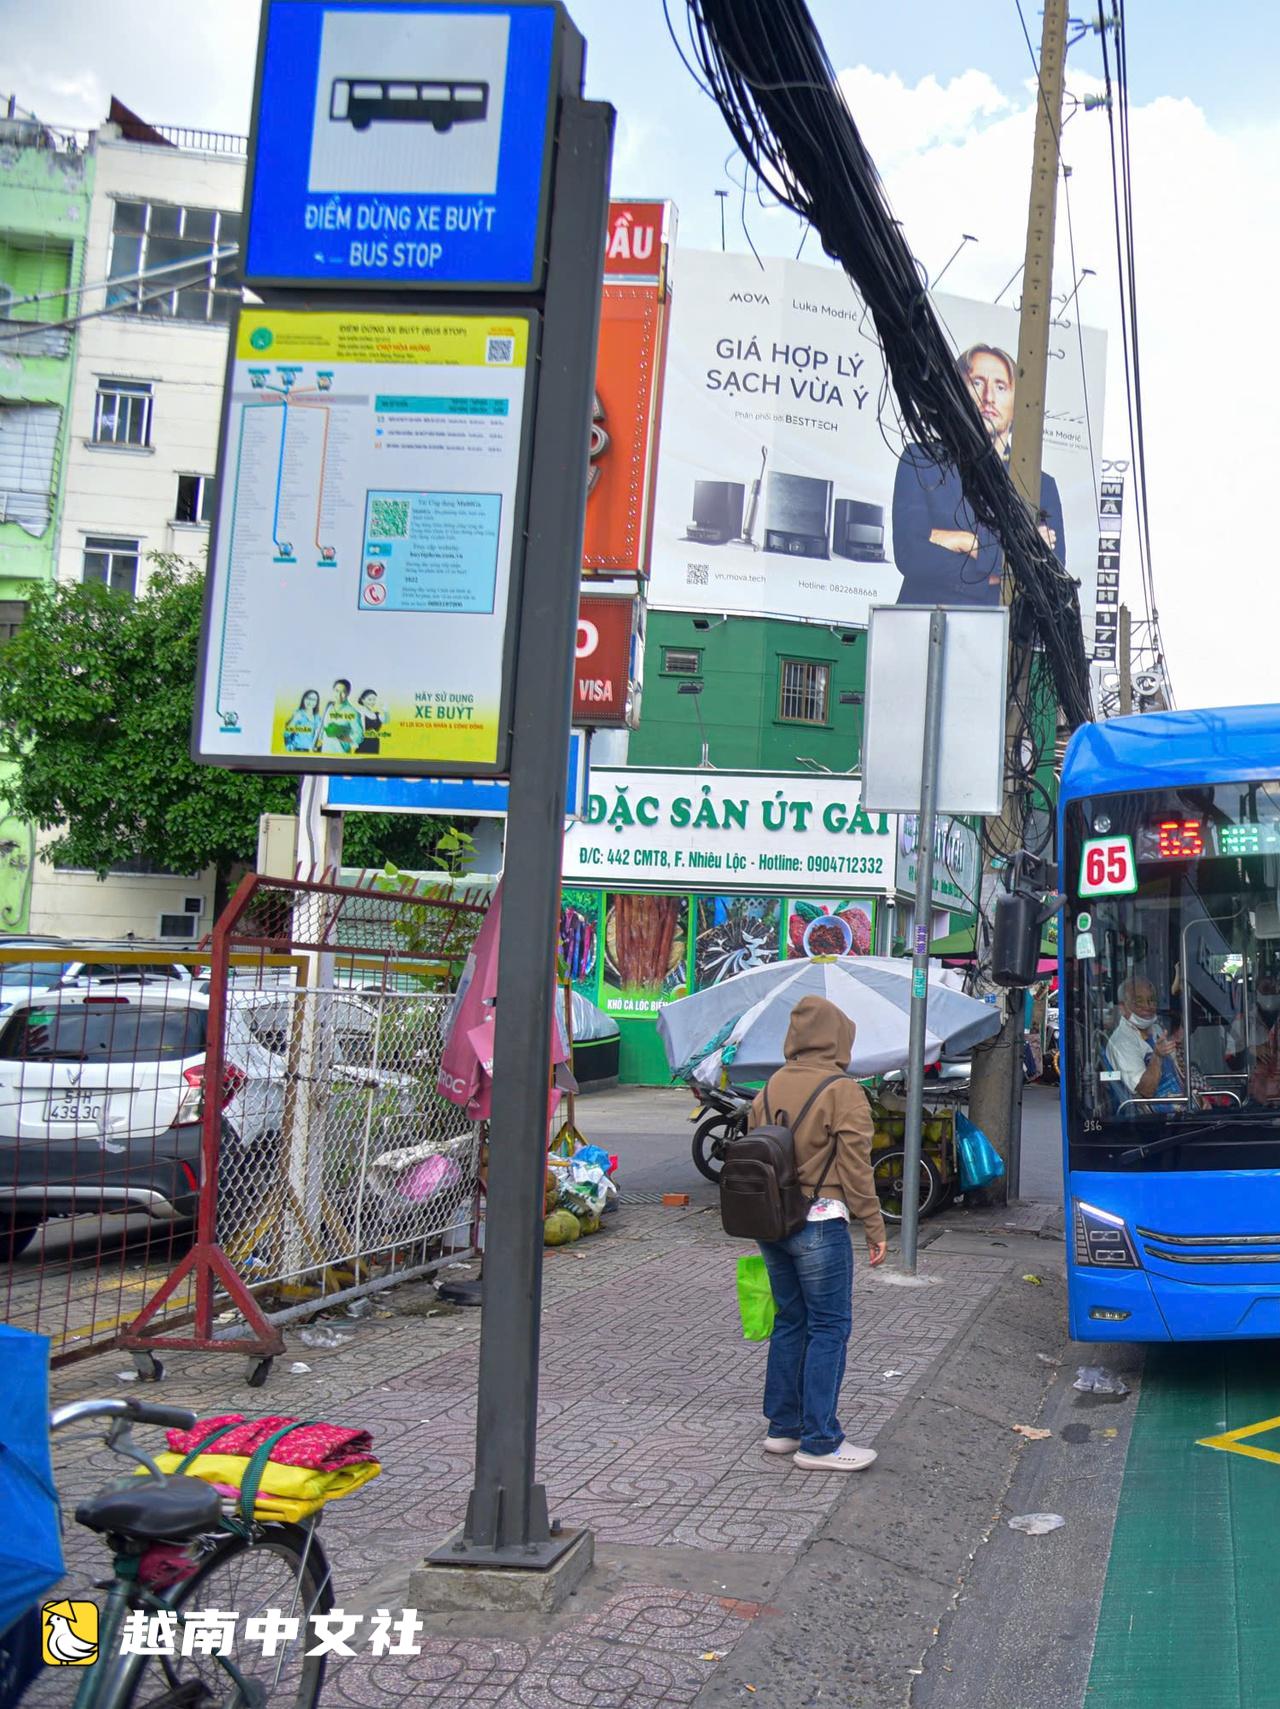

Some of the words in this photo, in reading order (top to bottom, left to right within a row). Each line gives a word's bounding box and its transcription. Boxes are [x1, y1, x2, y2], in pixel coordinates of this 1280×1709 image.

[304, 196, 351, 230] ĐIỂM
[358, 199, 411, 231] DỪNG
[416, 208, 441, 231] XE
[445, 200, 496, 232] BUÝT
[606, 211, 655, 260] ẦU
[349, 242, 388, 267] BUS
[392, 243, 443, 268] STOP
[729, 292, 771, 305] MOVA
[792, 299, 818, 314] Luka
[821, 305, 858, 322] Modrić
[716, 335, 762, 362] GIÁ
[771, 342, 829, 374] HỢP
[837, 352, 865, 378] LÝ
[706, 369, 781, 398] SẠCH
[790, 376, 844, 407] VỪA
[853, 384, 869, 410] Ý
[785, 414, 838, 433] BESTTECH
[714, 572, 767, 584] vn.mova.tech
[798, 579, 828, 592] Hotline:
[579, 679, 613, 702] VISA
[415, 705, 433, 719] XE
[437, 702, 474, 720] BUÝT
[585, 785, 660, 833] ĐẶC
[670, 785, 750, 830] SẢN
[761, 790, 813, 832] ÚT
[579, 847, 605, 865] Đ/C:
[607, 849, 630, 866] 442
[633, 850, 671, 869] CMT8,
[689, 852, 722, 869] Nhiêu
[726, 853, 747, 873] Lộc
[759, 854, 803, 872] Hotline:
[807, 855, 884, 874] 0904712332
[1086, 845, 1127, 887] 65
